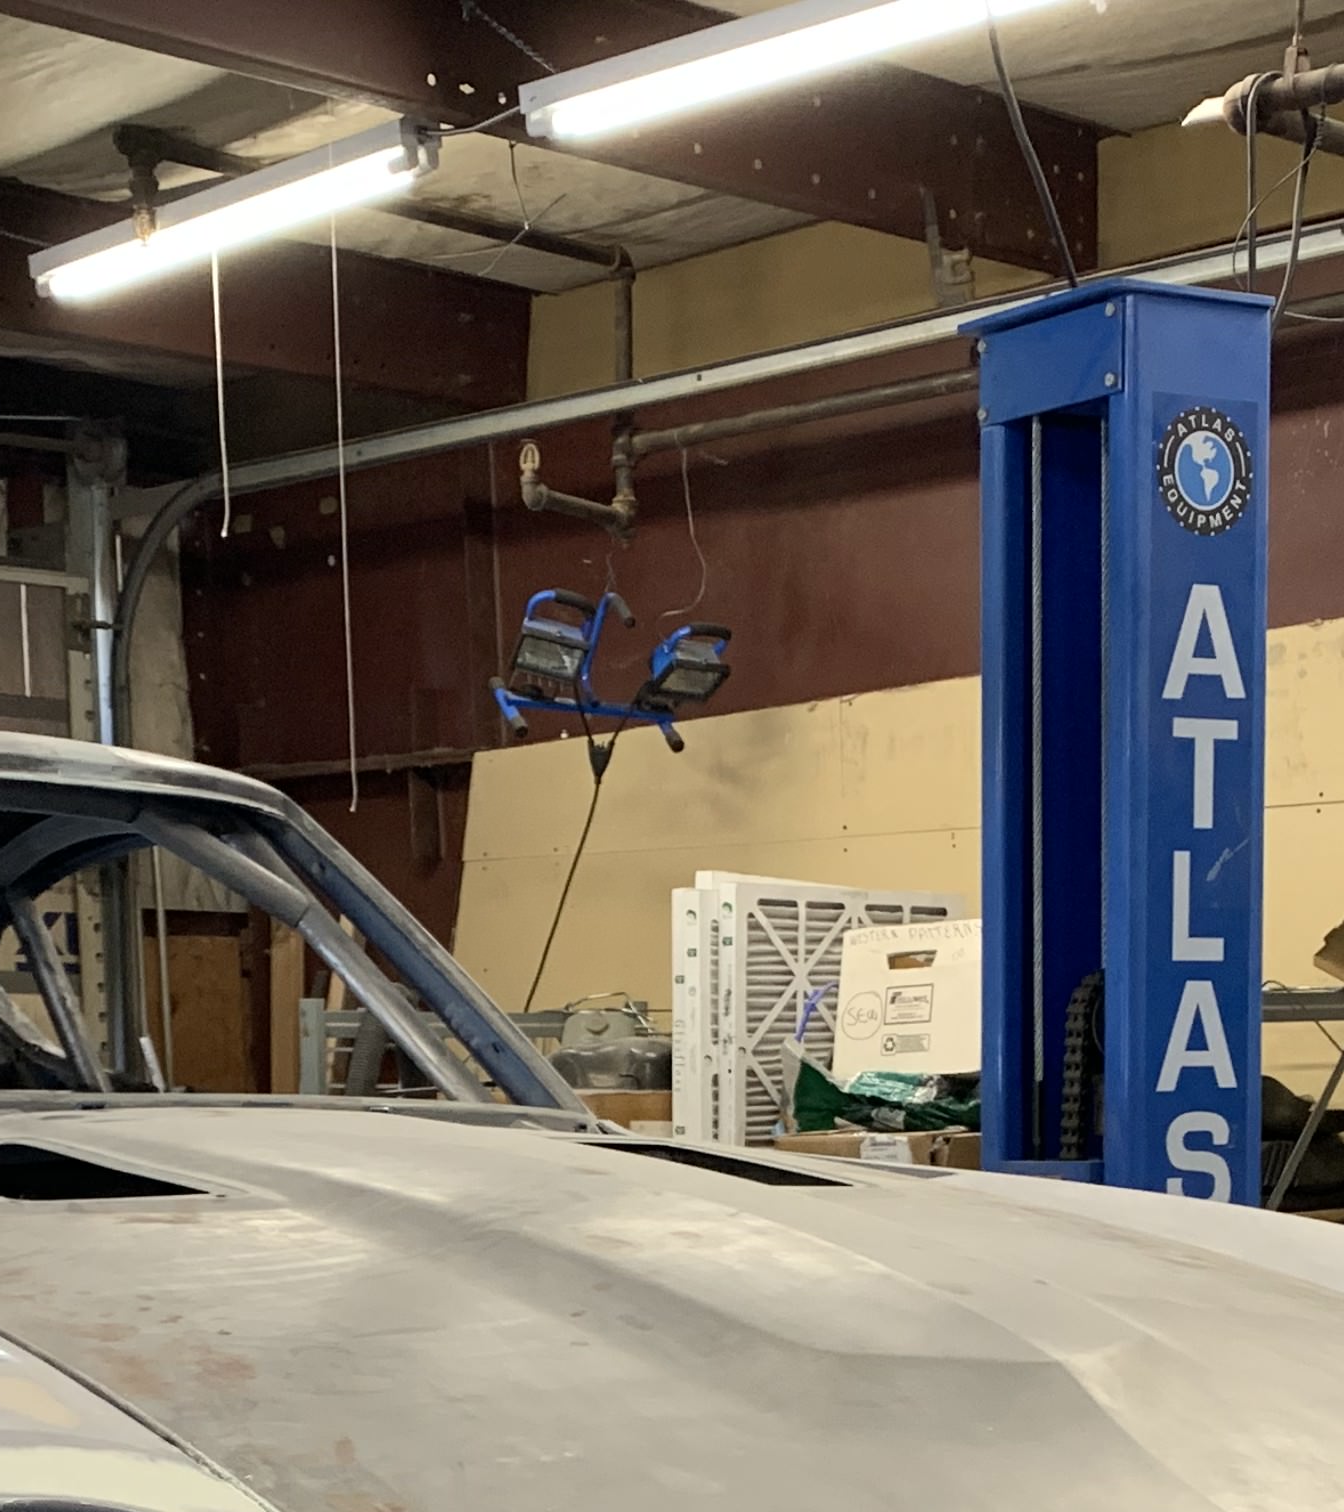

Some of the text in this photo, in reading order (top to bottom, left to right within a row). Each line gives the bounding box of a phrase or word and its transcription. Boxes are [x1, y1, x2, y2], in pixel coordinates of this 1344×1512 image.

[1177, 414, 1236, 442] ATLAS
[1162, 473, 1247, 529] EQUIPMENT
[1155, 583, 1246, 1203] ATLAS
